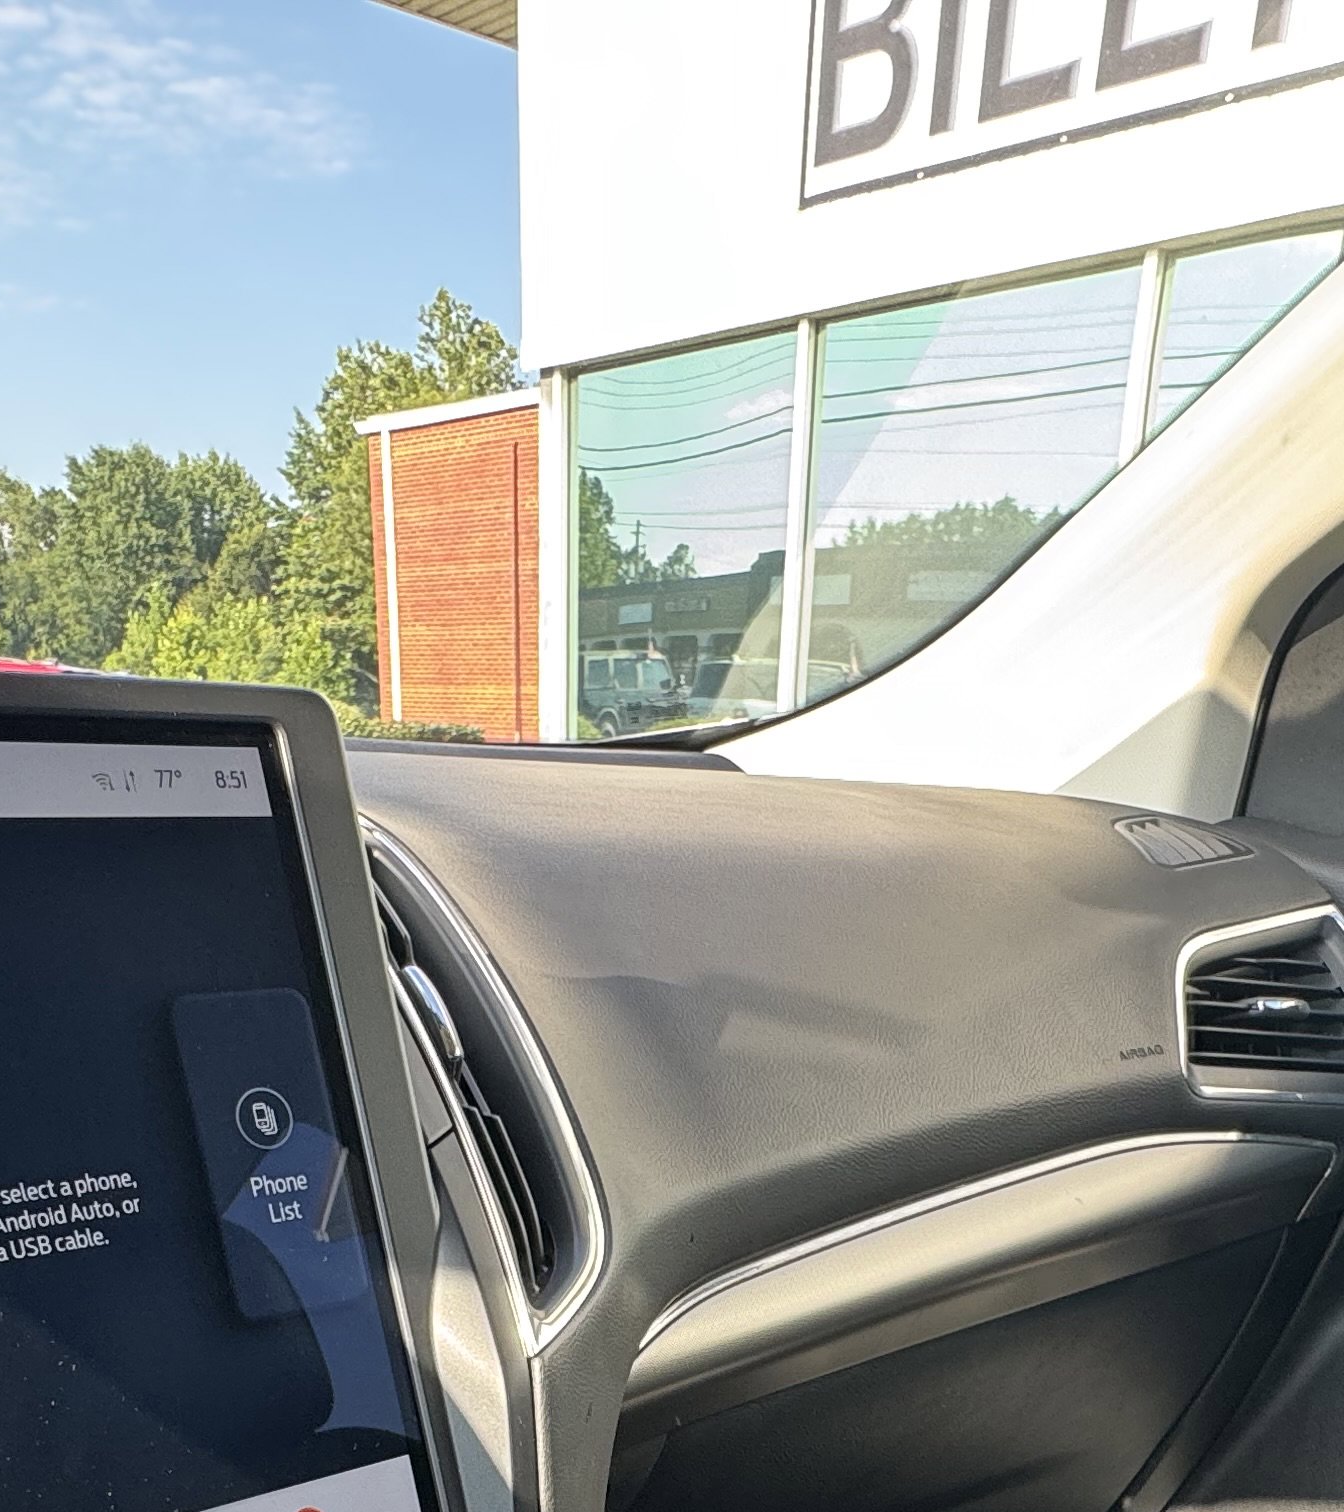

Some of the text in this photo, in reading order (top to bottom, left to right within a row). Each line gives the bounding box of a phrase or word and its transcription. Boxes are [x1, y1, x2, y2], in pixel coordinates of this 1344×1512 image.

[215, 770, 248, 789] 8:51
[1119, 1044, 1164, 1061] AIRBAG
[0, 1179, 57, 1206] select
[59, 1181, 73, 1197] a
[74, 1172, 138, 1198] phone,
[250, 1174, 308, 1198] Phone
[70, 1200, 121, 1223] Auto,
[122, 1198, 141, 1214] or
[268, 1200, 303, 1224] List
[9, 1235, 53, 1260] USB
[54, 1228, 110, 1252] cable.
